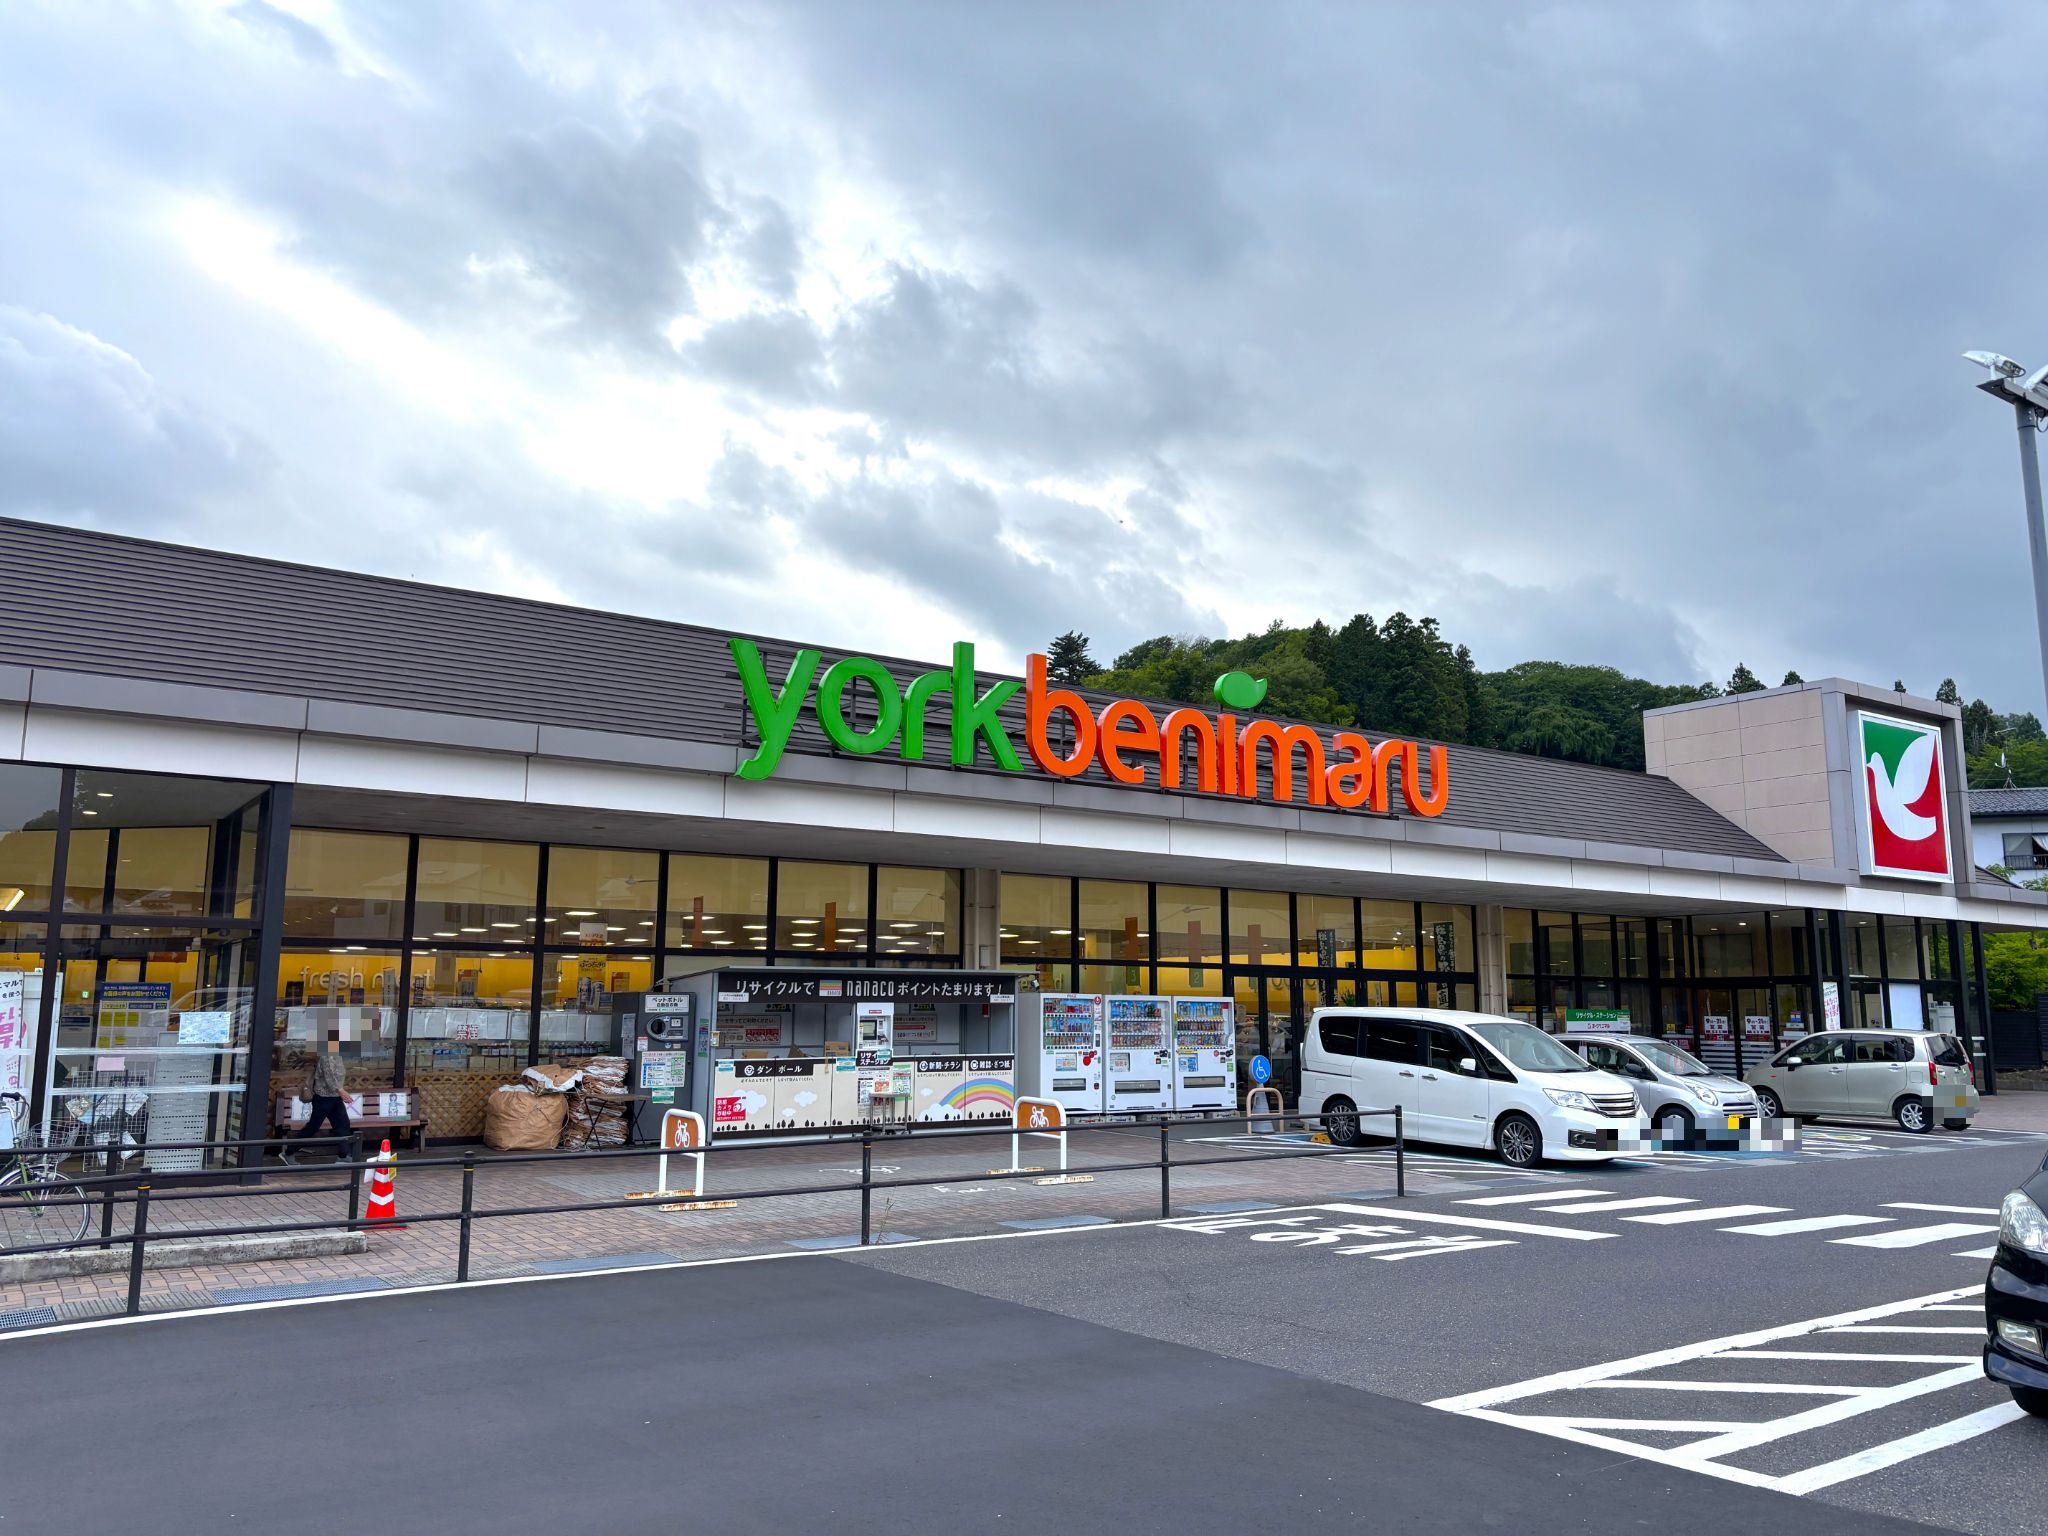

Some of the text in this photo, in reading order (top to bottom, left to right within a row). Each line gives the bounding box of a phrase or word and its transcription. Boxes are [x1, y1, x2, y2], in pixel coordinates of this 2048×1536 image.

[728, 639, 1448, 818] york benimaru
[736, 980, 815, 996] リサイクルで
[846, 980, 895, 997] nanaco
